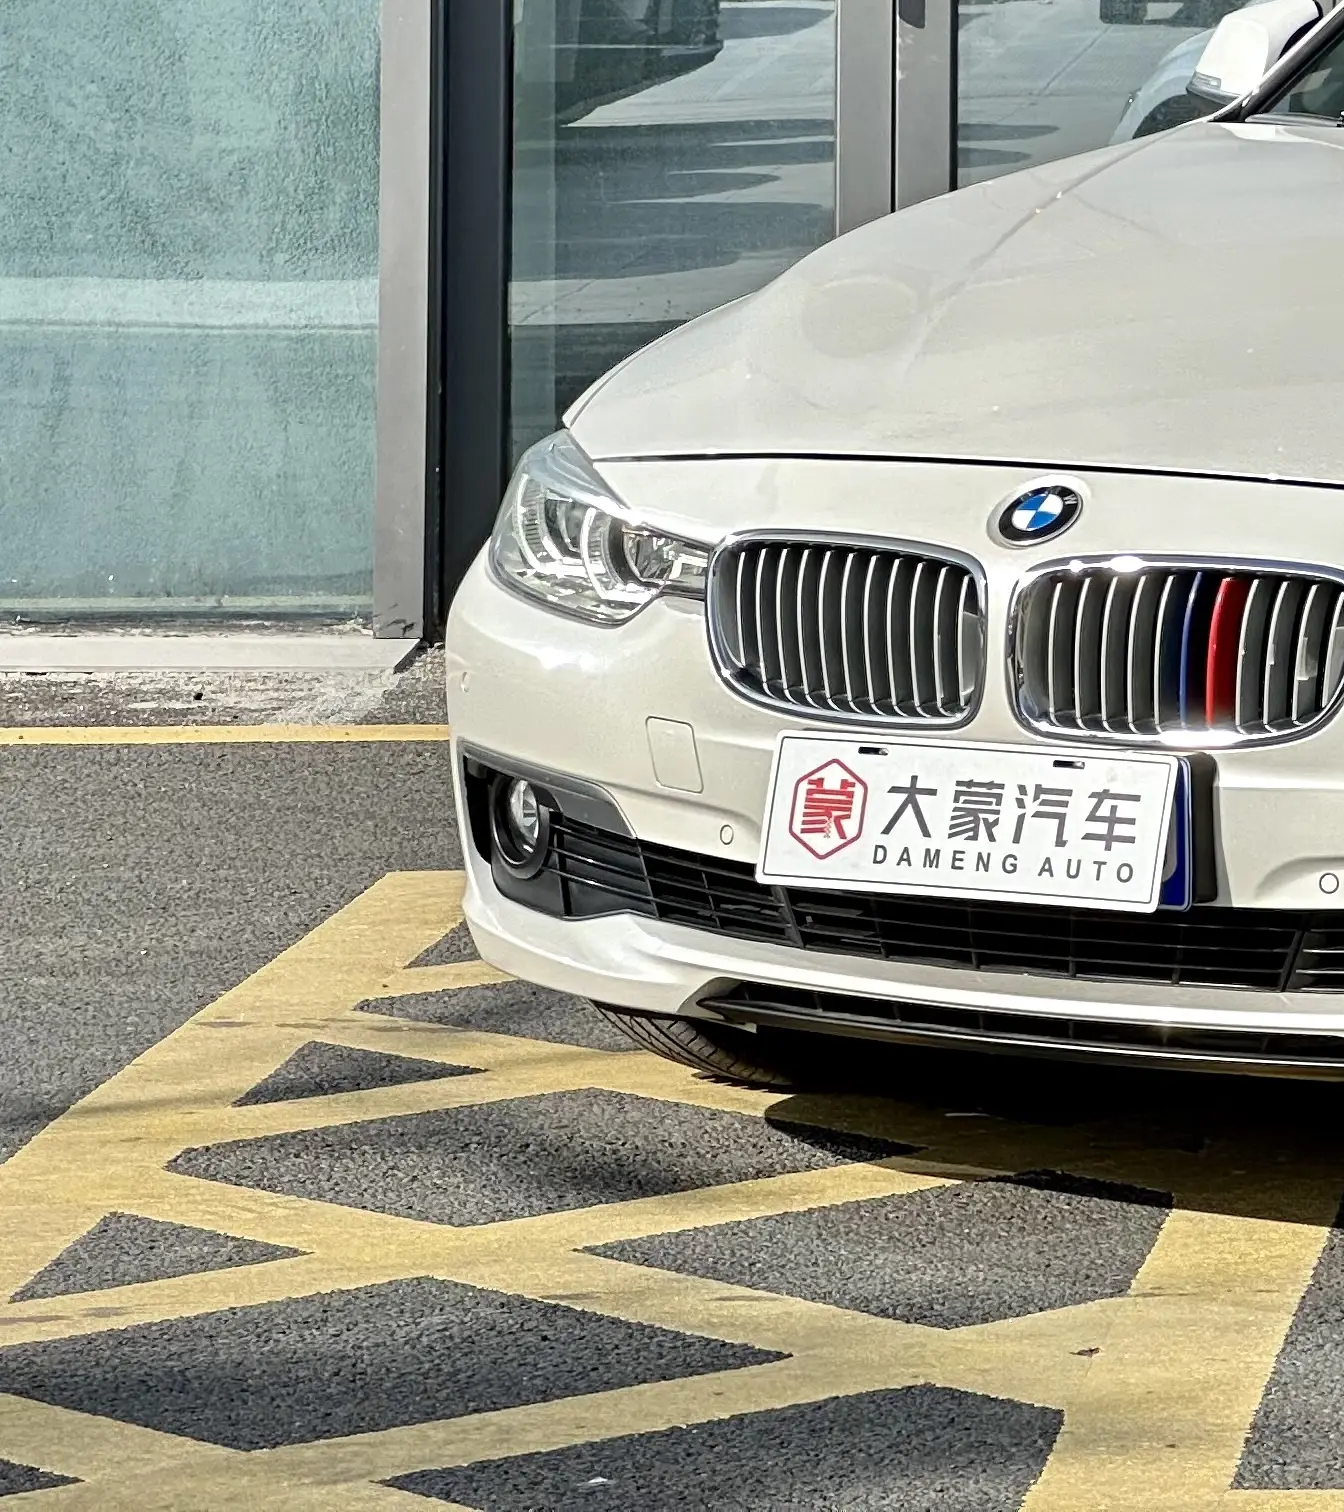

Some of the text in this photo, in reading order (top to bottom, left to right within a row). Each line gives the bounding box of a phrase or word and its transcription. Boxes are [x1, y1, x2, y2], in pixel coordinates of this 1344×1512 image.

[880, 775, 1142, 852] 大蒙汽车
[872, 844, 1134, 883] DAMENG AUTO
